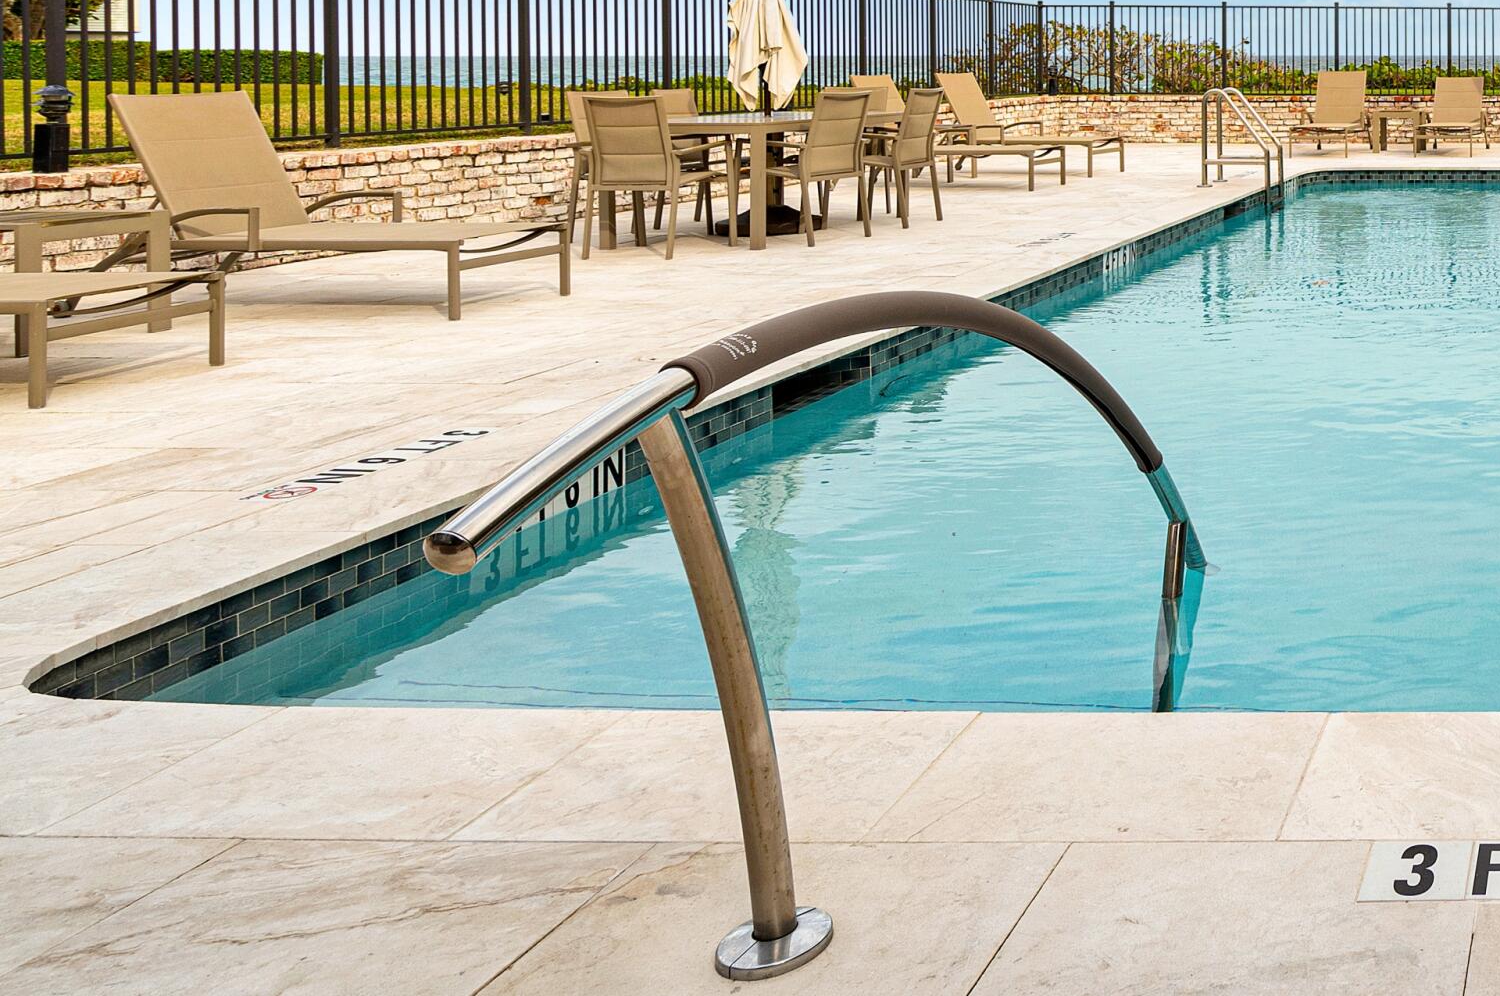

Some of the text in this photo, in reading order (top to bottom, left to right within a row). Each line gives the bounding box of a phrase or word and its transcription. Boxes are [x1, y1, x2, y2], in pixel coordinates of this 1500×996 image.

[294, 429, 489, 484] 3 FT 6 IN
[593, 448, 623, 498] IN
[1393, 844, 1438, 896] 3
